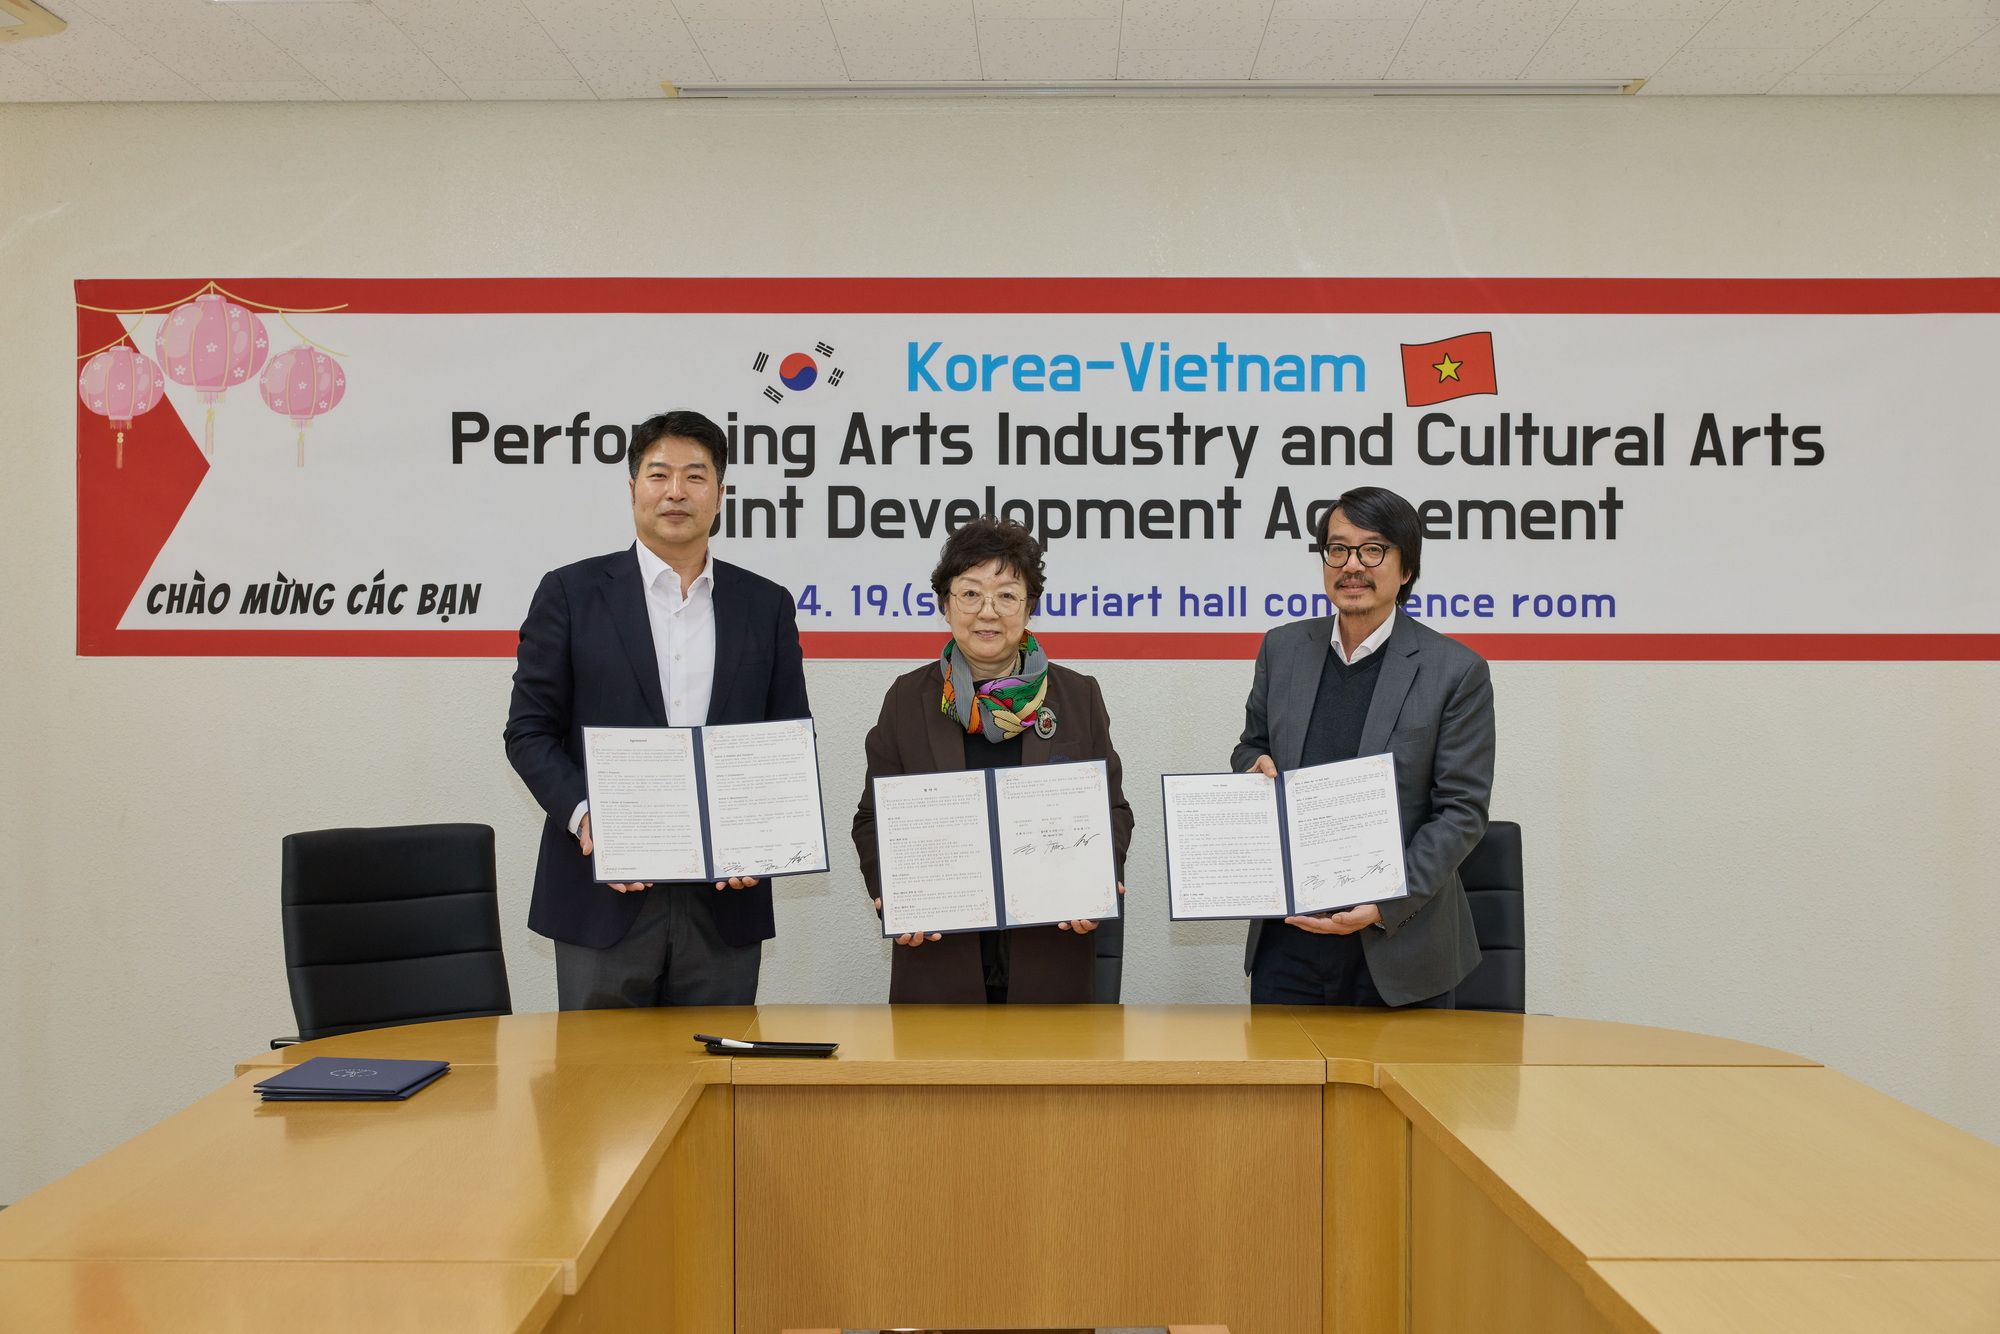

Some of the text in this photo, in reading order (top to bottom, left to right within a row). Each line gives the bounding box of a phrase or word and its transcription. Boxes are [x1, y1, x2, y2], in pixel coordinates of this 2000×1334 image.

[907, 341, 1366, 393] Korea-Vietnam
[452, 412, 1825, 478] Perfoing Arts Industry and Cultural Arts
[709, 485, 1624, 553] int Development Agement
[146, 568, 483, 624] CHÀO MỪNG CÁC BẠN
[1030, 585, 1162, 617] uriart
[1179, 585, 1247, 617] hall
[1264, 593, 1495, 618] conence
[1512, 593, 1616, 618] room
